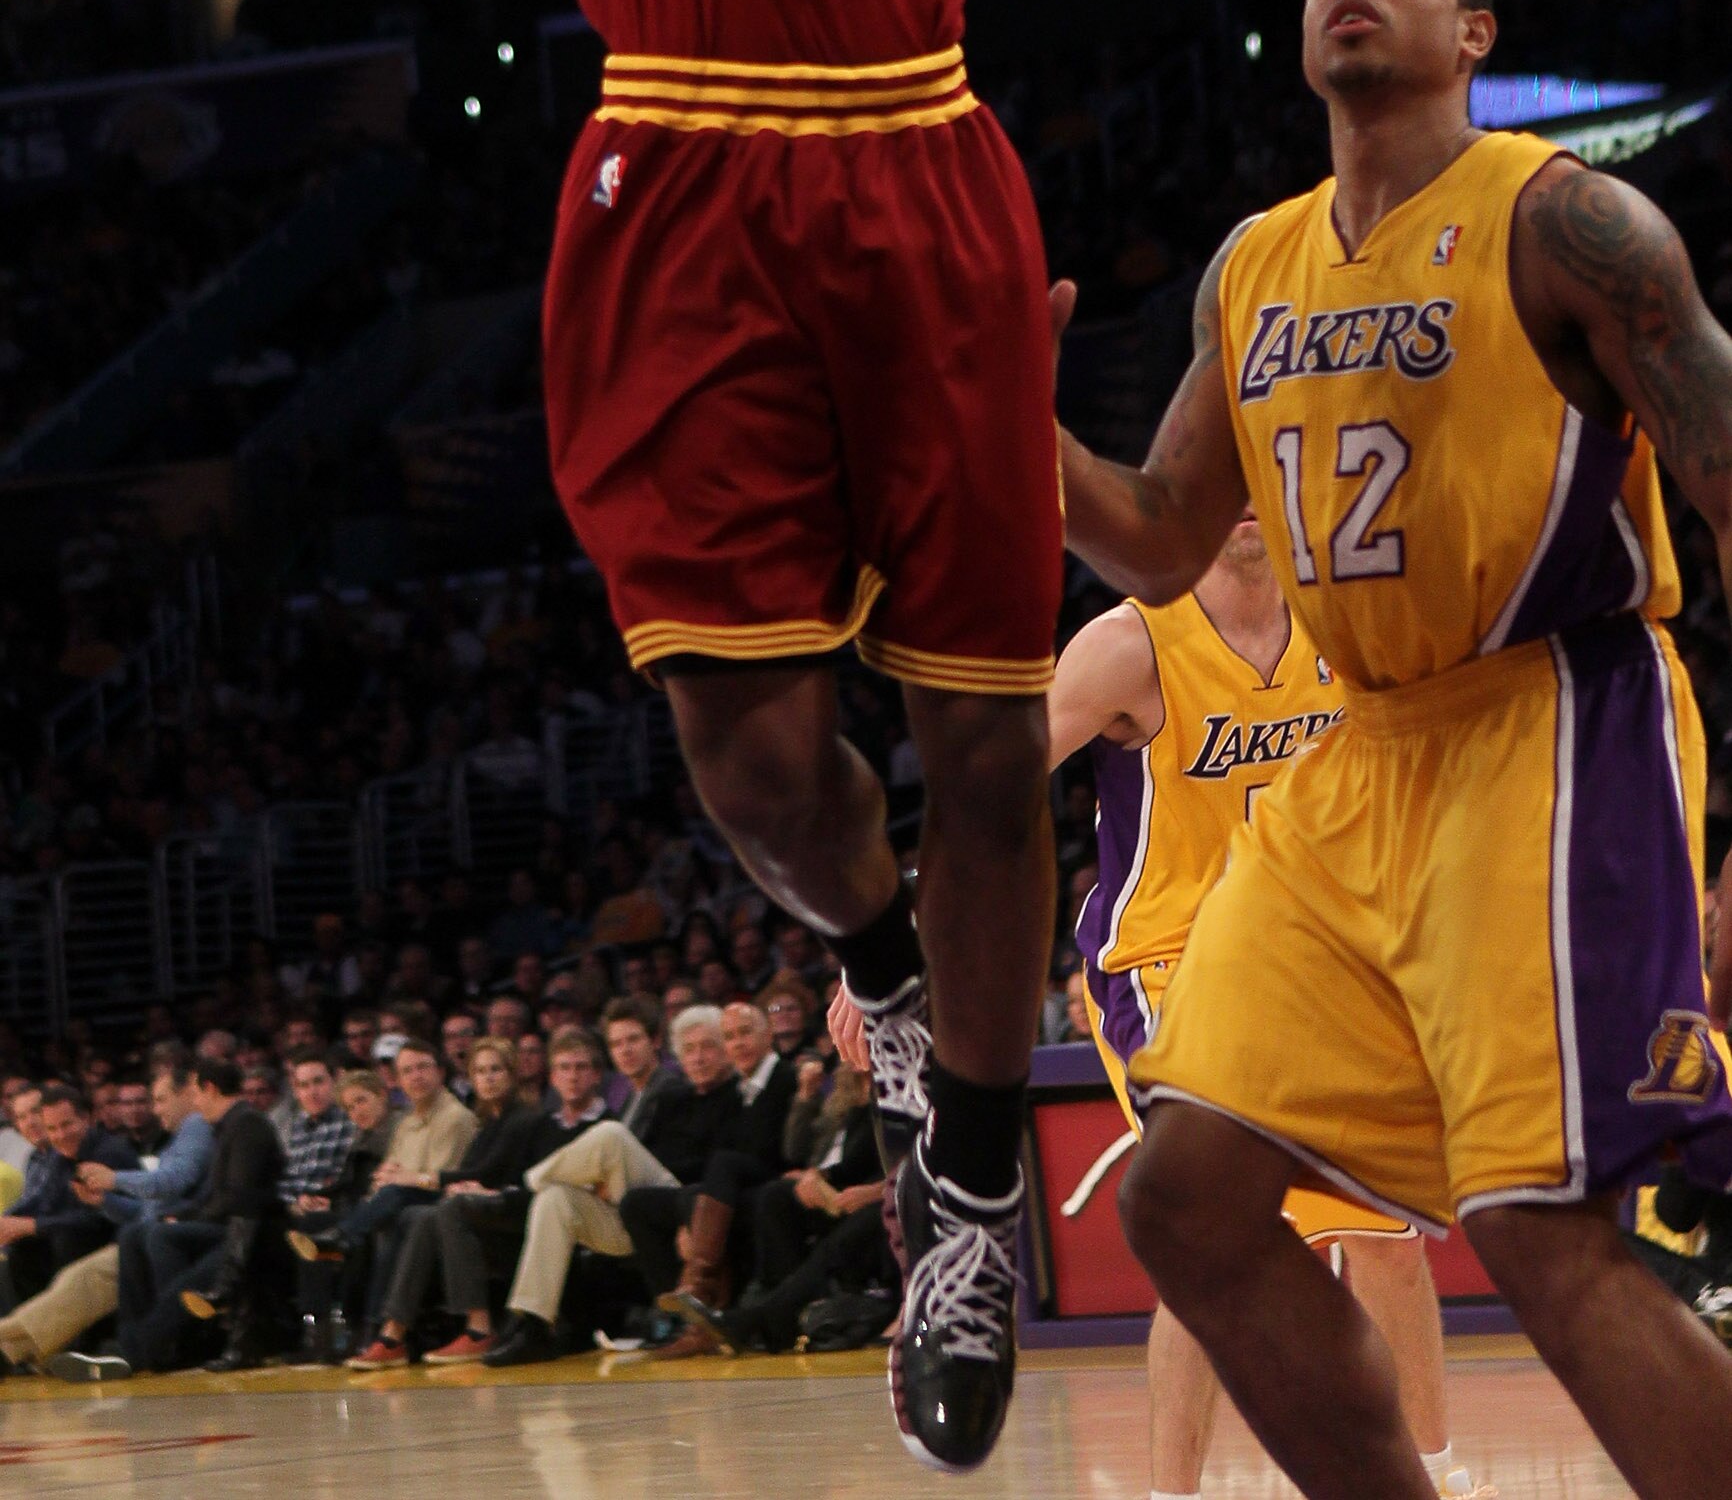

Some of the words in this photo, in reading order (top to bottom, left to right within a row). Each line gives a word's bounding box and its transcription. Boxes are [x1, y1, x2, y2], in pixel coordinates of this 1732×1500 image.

[1240, 299, 1457, 406] LAKERS
[1273, 419, 1412, 586] 12
[1184, 704, 1345, 780] LAKER
